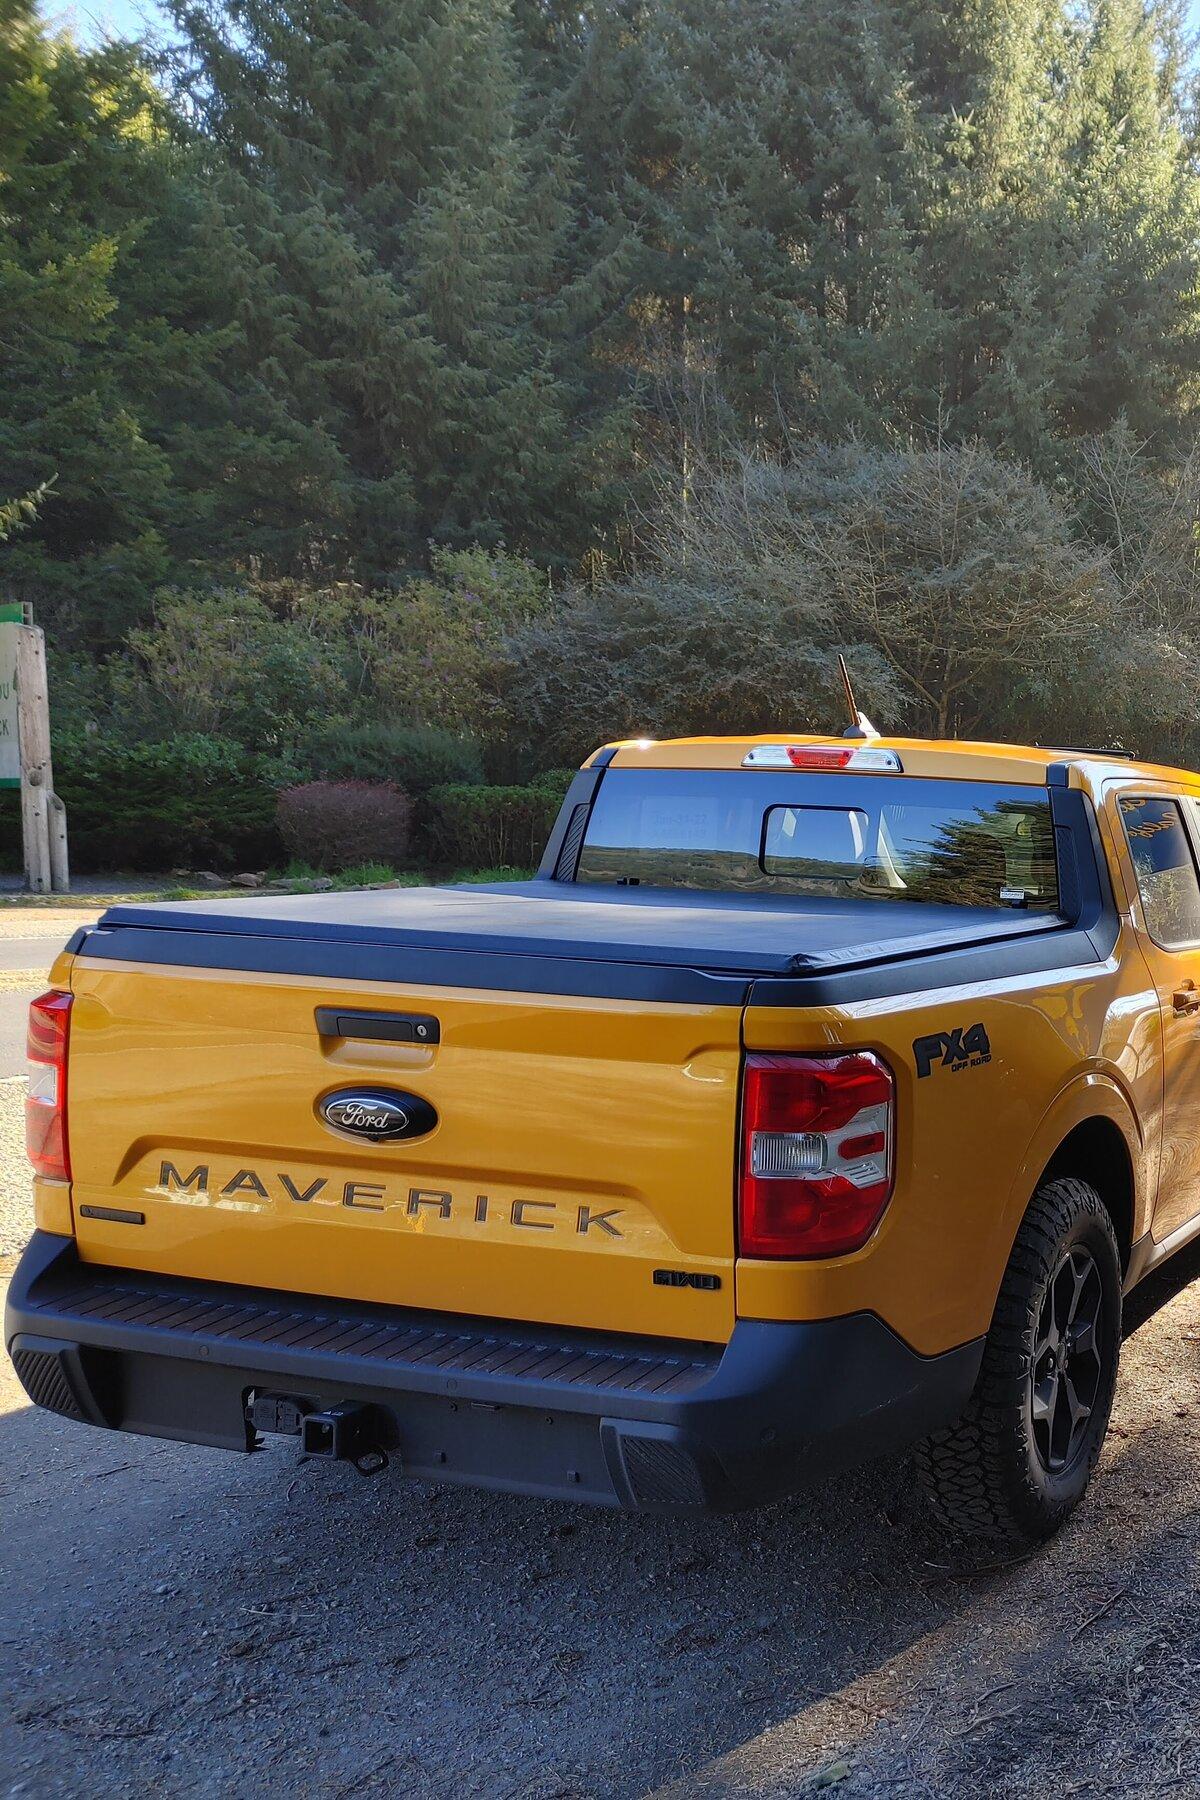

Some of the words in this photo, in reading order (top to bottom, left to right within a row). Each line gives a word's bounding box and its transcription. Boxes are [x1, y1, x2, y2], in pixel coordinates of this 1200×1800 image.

[912, 1022, 991, 1078] FX4
[951, 1060, 969, 1073] OFF
[970, 1054, 992, 1068] ROAD
[340, 1102, 390, 1129] Ford
[158, 1160, 626, 1239] MAVERICK
